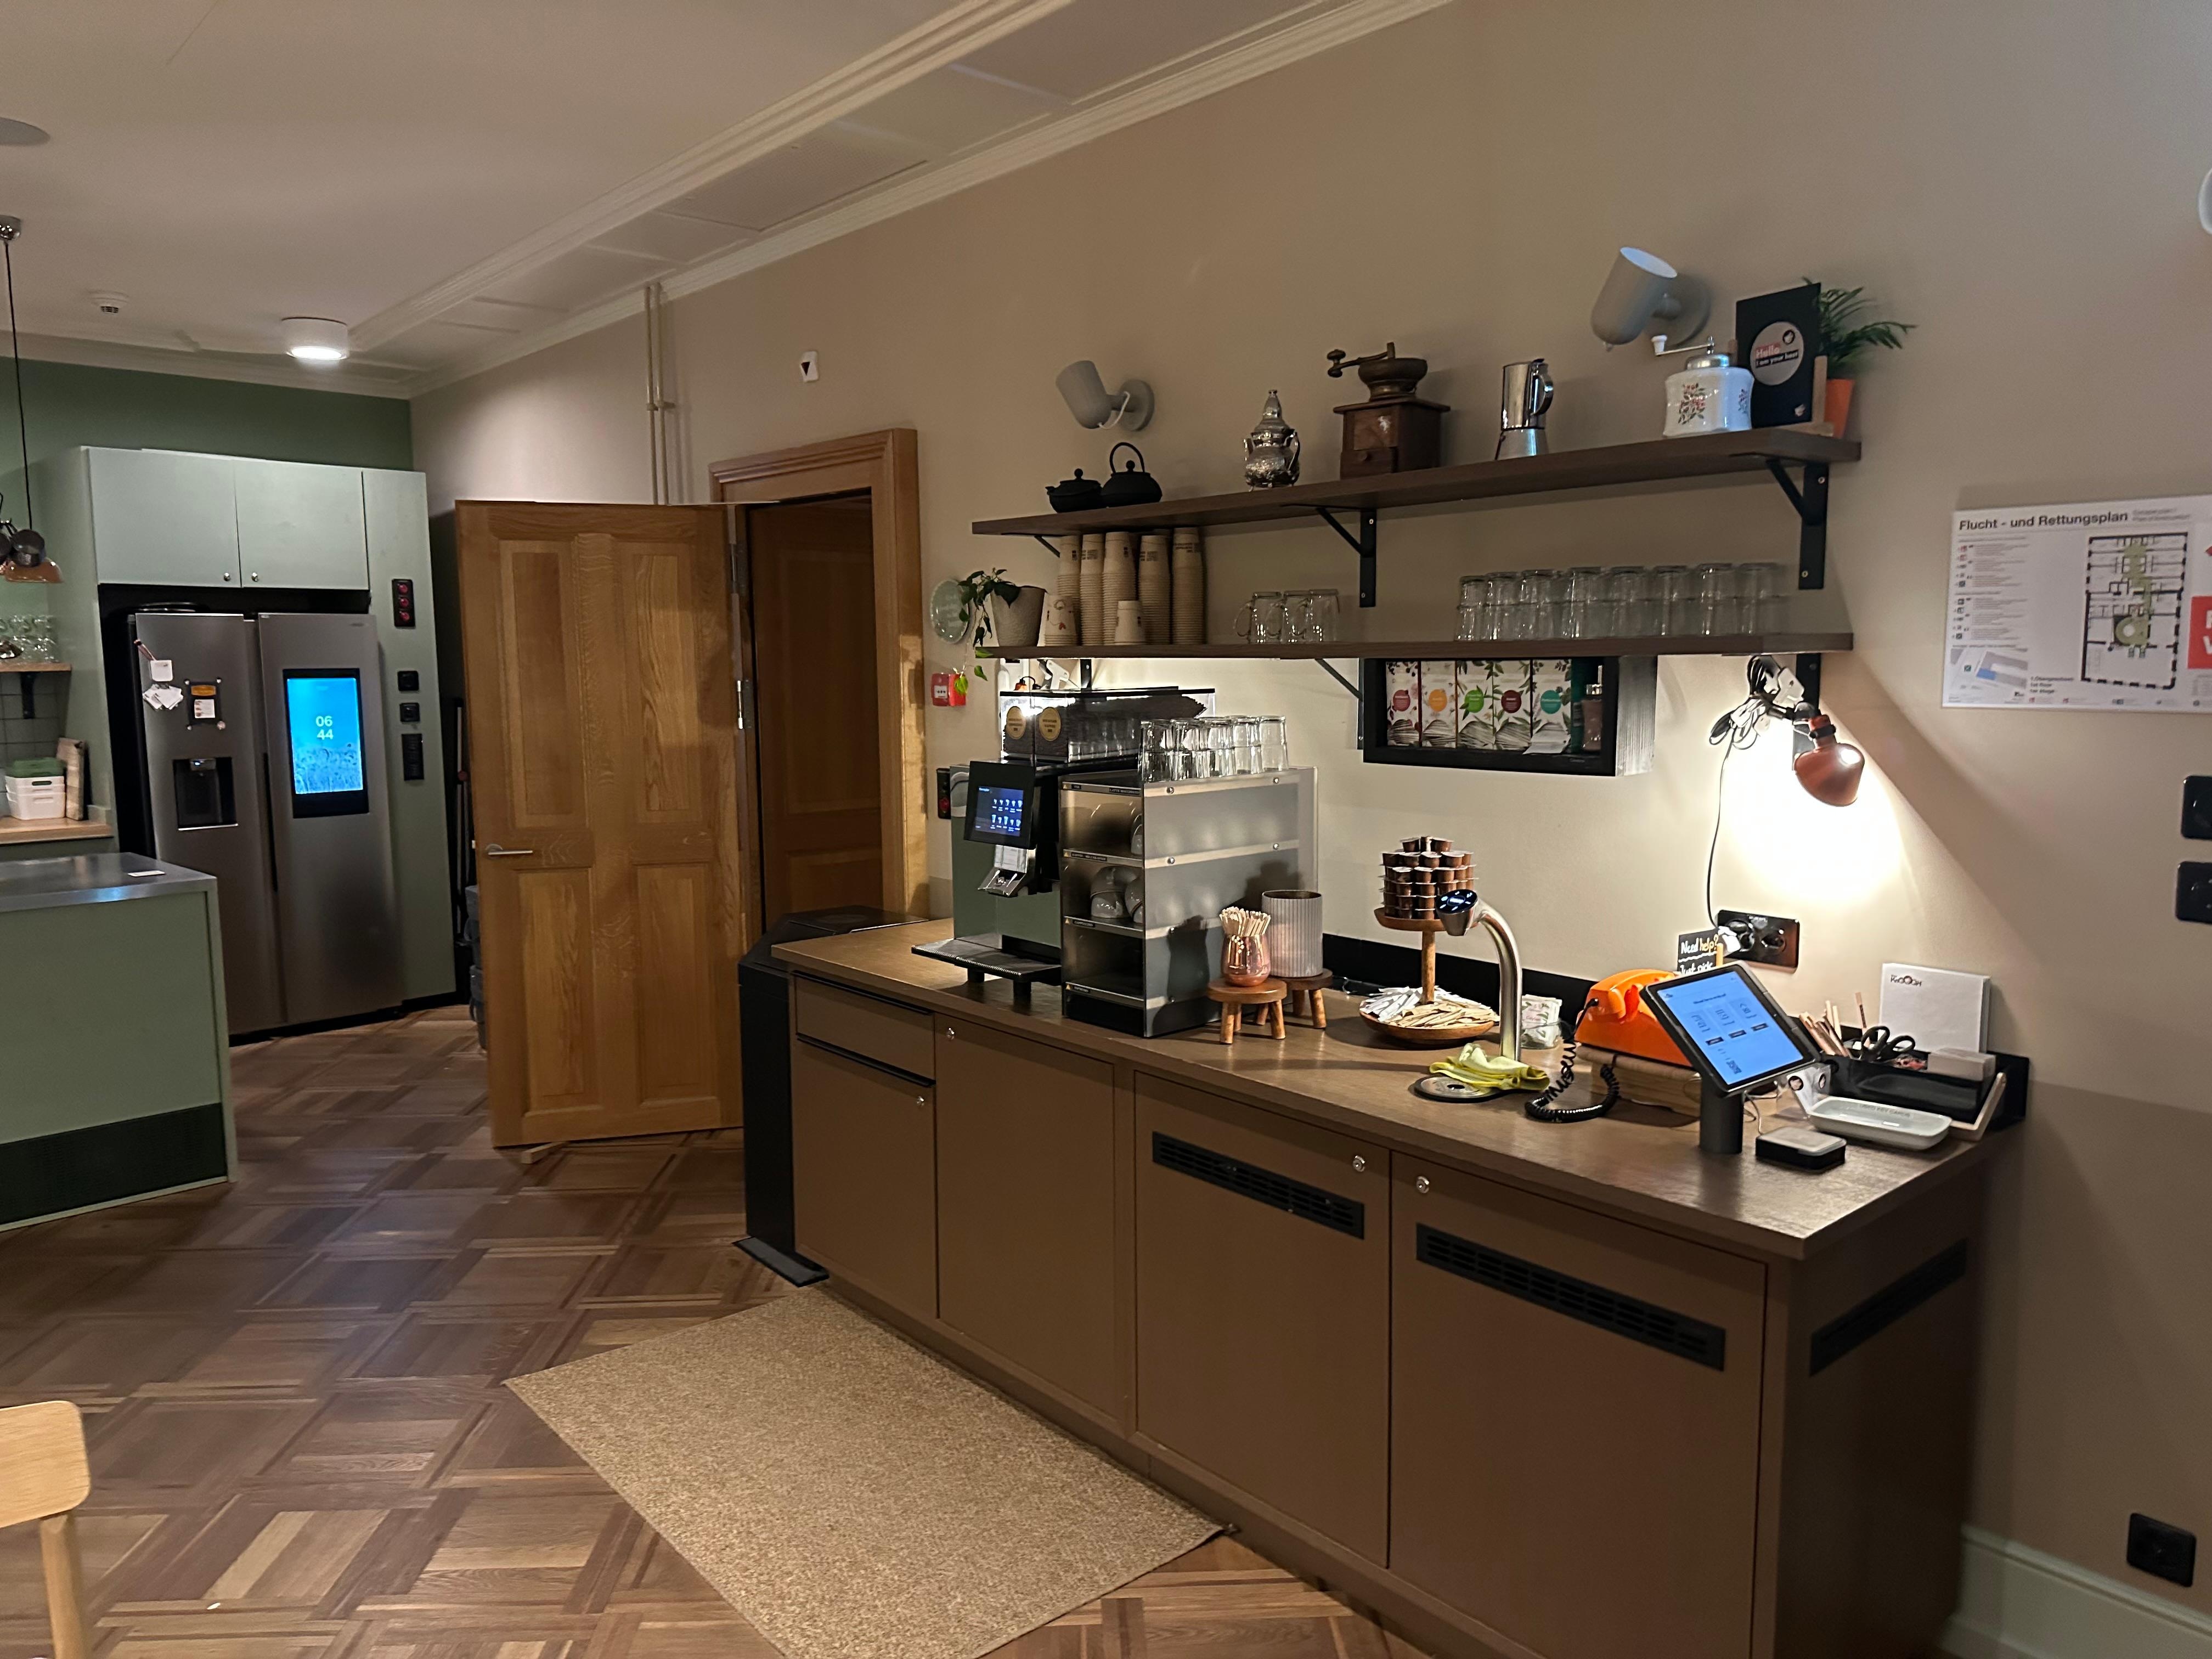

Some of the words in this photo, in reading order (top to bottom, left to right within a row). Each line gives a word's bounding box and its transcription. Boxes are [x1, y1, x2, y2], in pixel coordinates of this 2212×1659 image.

[1959, 520, 1997, 531] Flucht
[2010, 516, 2035, 528] und
[2039, 511, 2128, 526] Rettungsplan
[315, 715, 333, 727] 06
[317, 729, 334, 740] 44
[1680, 937, 1699, 953] Need
[1700, 934, 1718, 953] help?
[1680, 963, 1696, 975] Just
[1697, 961, 1713, 972] pick
